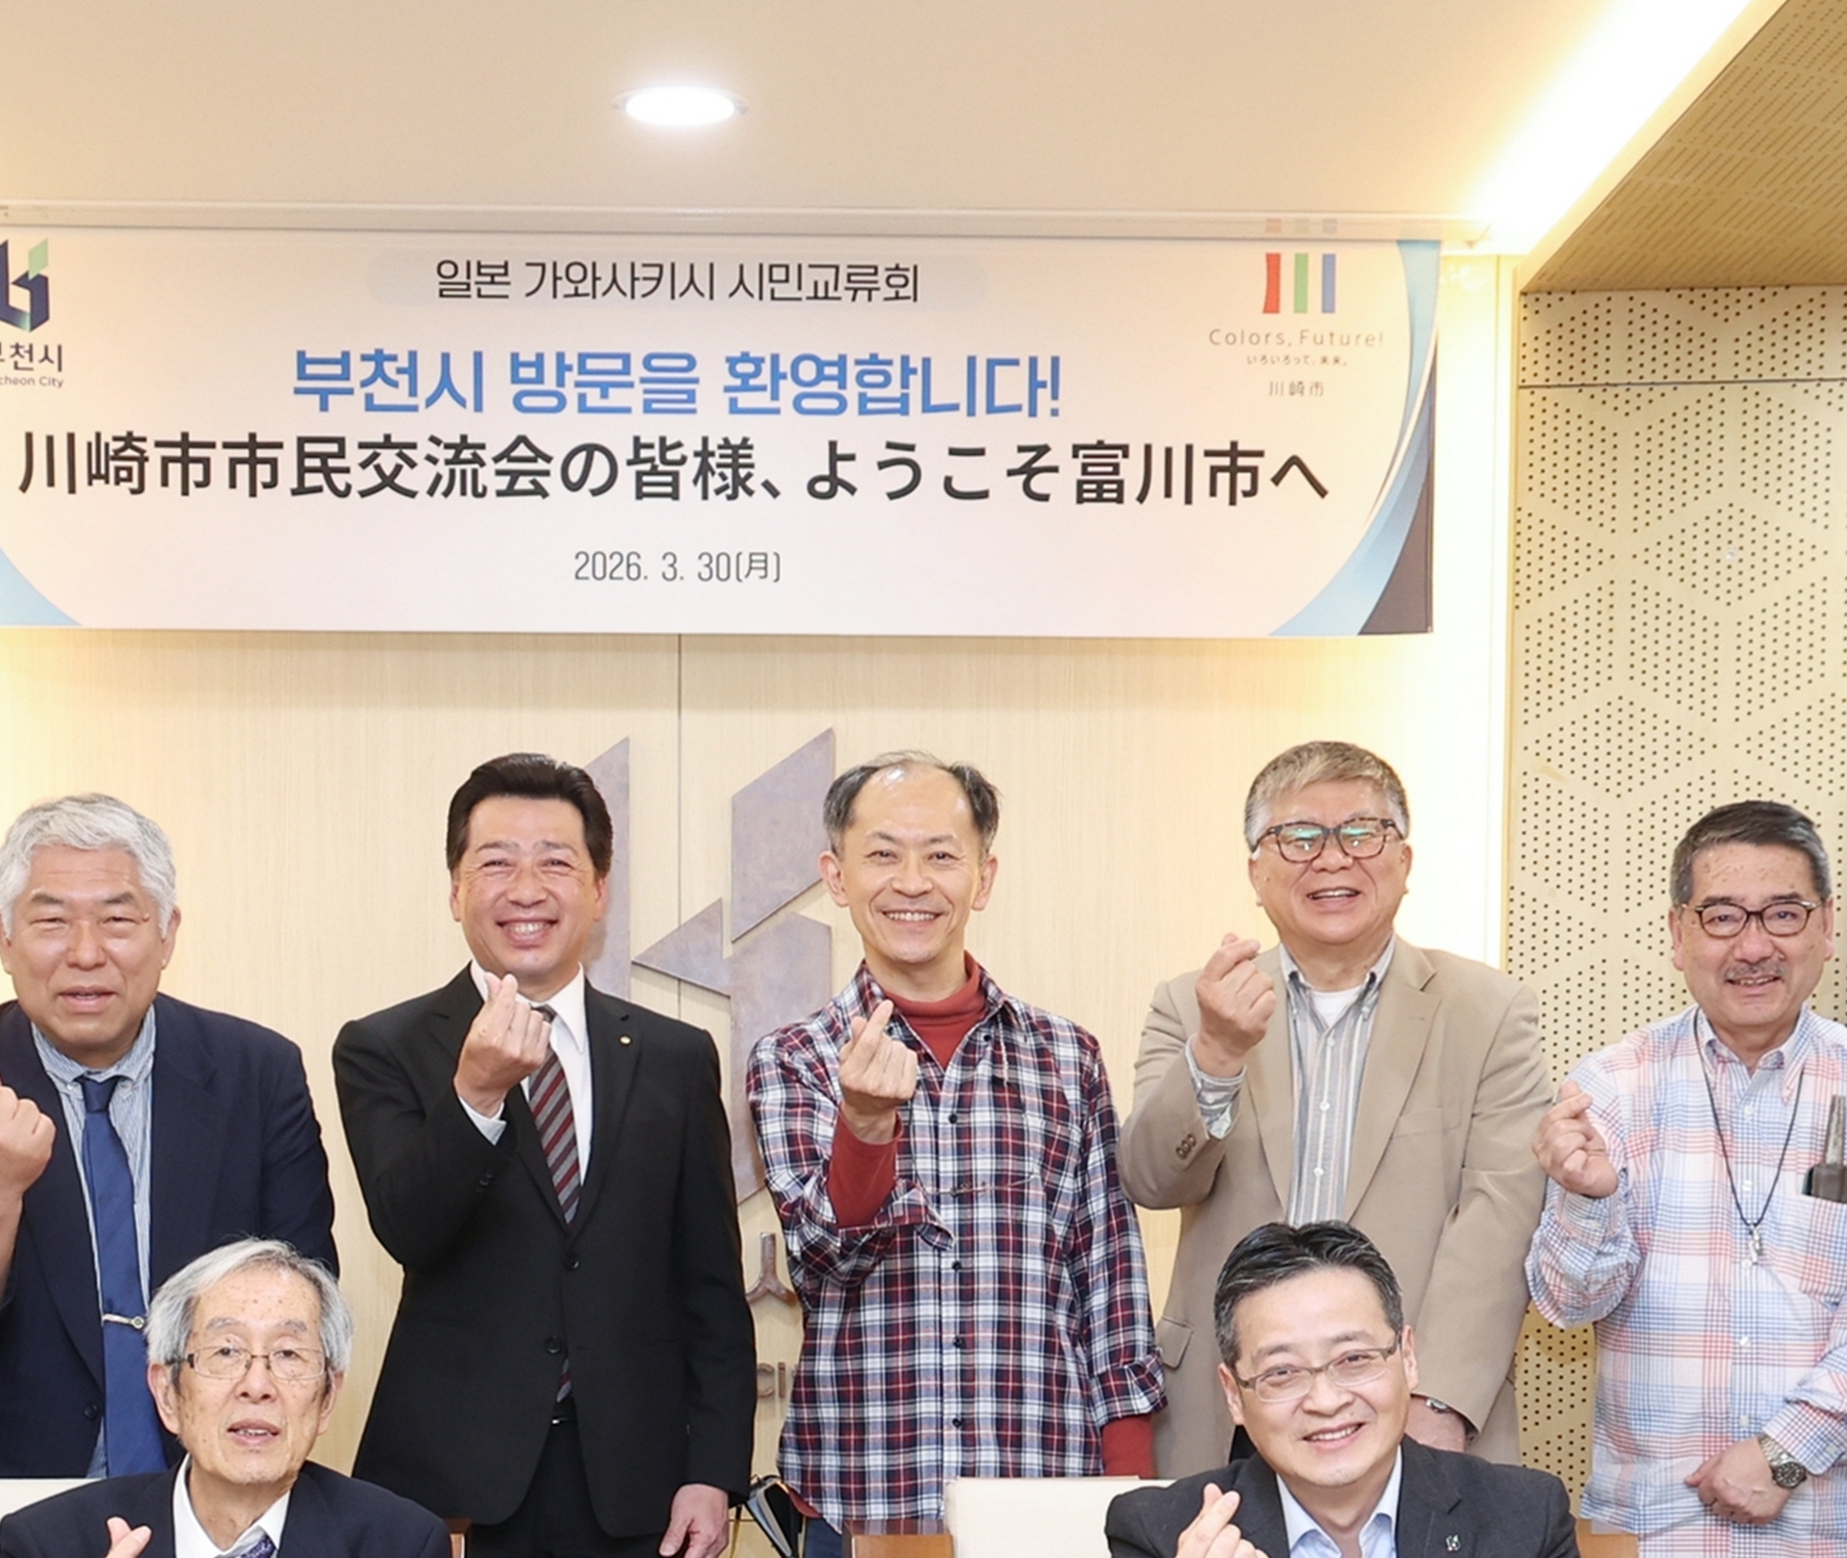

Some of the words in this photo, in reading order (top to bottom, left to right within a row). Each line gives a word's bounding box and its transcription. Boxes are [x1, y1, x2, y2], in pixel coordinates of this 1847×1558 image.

[435, 258, 511, 300] 일본
[524, 258, 715, 301] 가와사키시
[728, 261, 919, 303] 시민교류회
[1208, 328, 1292, 347] Colors,
[1299, 329, 1384, 347] Future!
[38, 375, 64, 388] City
[292, 347, 484, 414] 부천시
[509, 350, 701, 415] 방문을
[722, 350, 1061, 418] 환영합니다!
[1268, 380, 1325, 397] 川崎市
[18, 430, 1330, 507] 川崎市市民交流会の皆様、ようこそ富川市へ
[574, 550, 649, 582] 2026.
[661, 551, 685, 582] 3.
[697, 551, 781, 583] 30(月)
